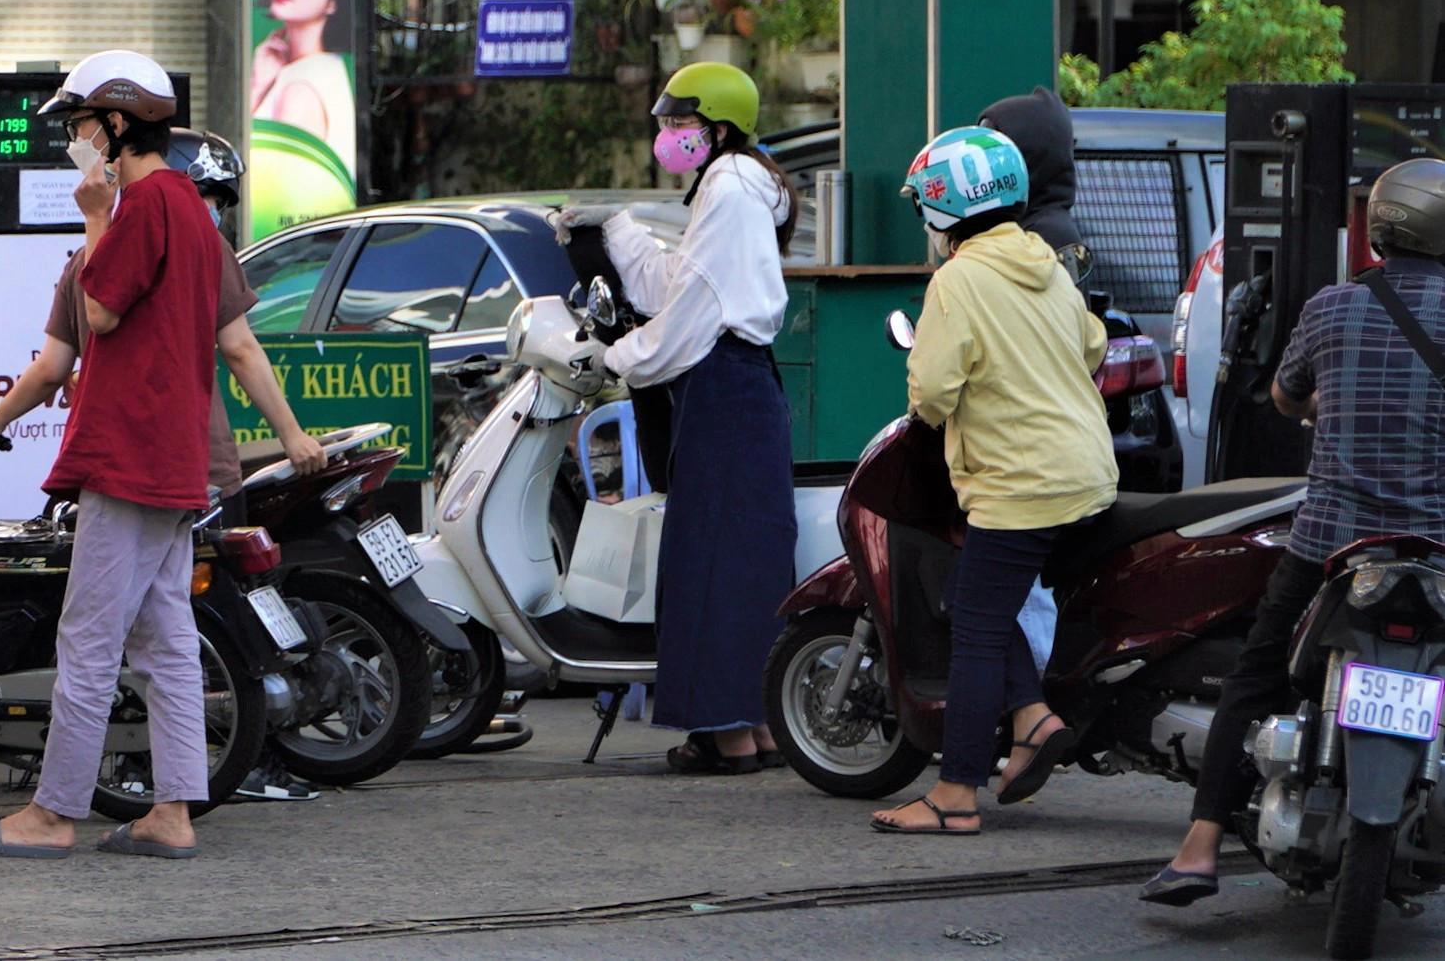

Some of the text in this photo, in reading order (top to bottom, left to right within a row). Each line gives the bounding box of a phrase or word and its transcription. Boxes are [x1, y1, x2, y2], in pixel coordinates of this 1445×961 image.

[966, 173, 1018, 203] LEOPARD
[302, 352, 413, 399] KHÁCH
[7, 421, 47, 441] Vượt
[365, 521, 401, 556] 59-F2
[378, 545, 419, 583] 231.52
[1360, 670, 1426, 706] 59-P1
[1347, 698, 1432, 735] 800.60
